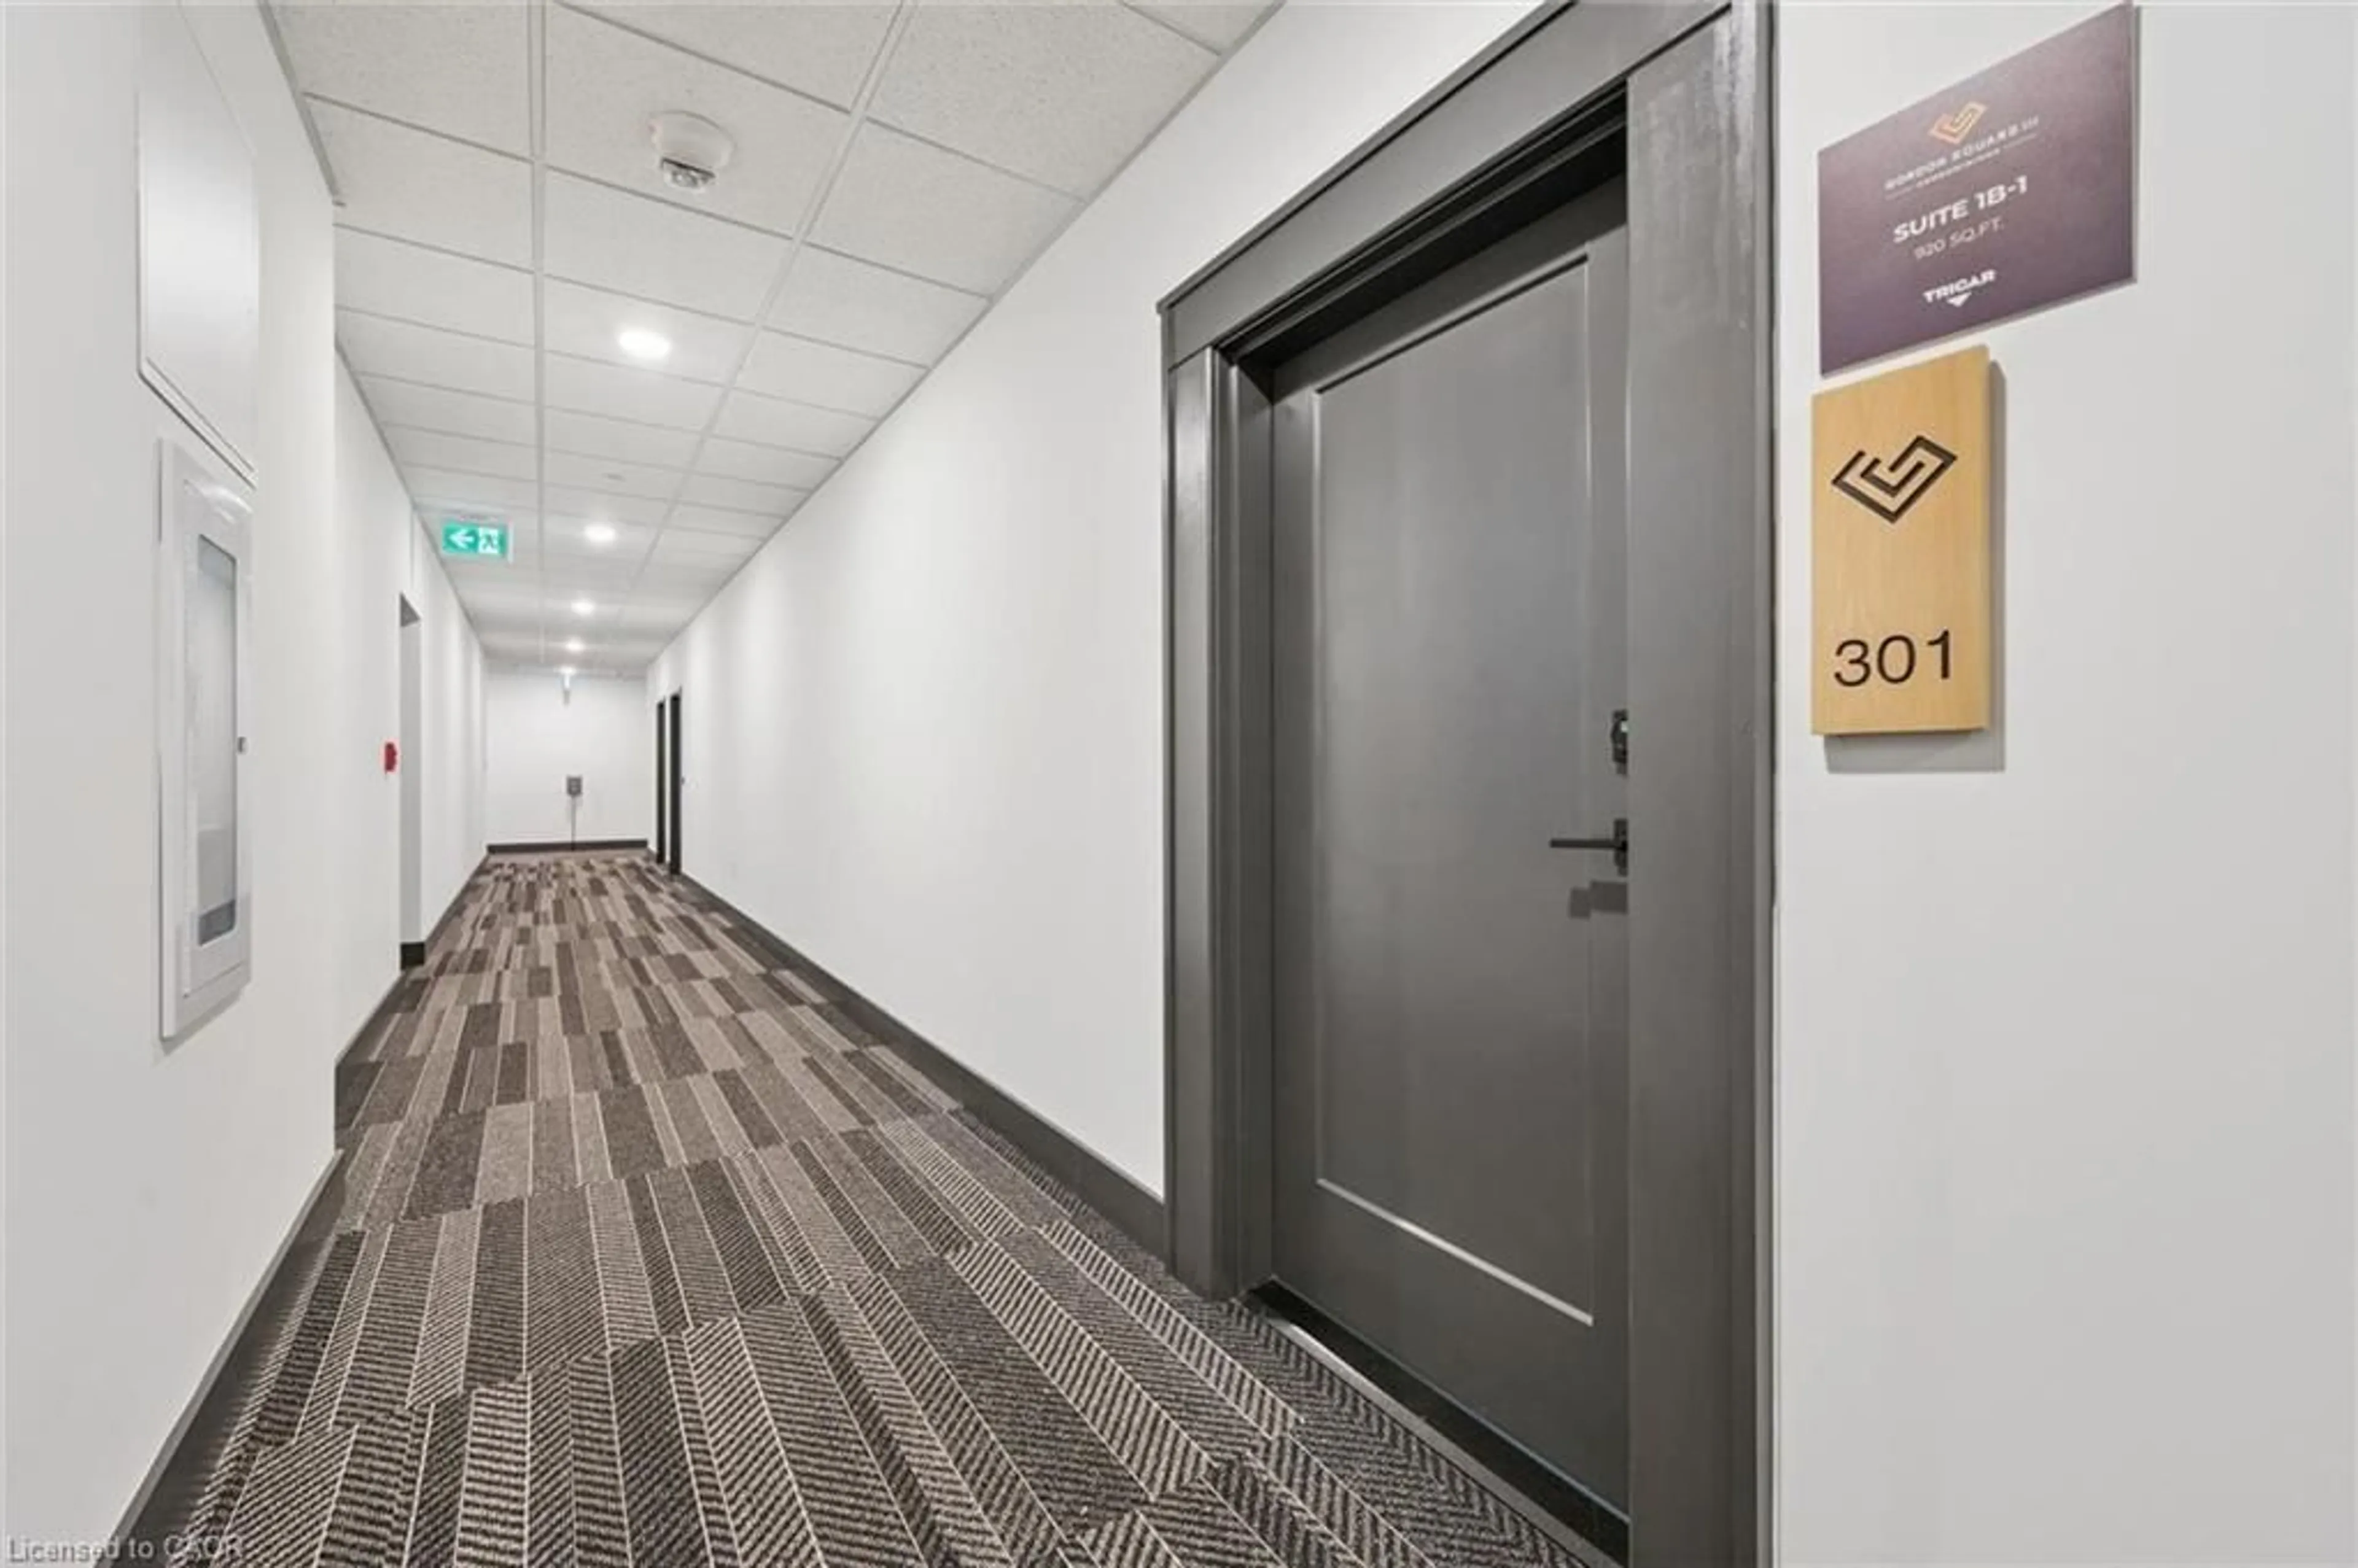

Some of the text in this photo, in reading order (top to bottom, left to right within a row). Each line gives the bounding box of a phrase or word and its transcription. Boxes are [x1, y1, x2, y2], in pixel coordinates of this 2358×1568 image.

[1893, 175, 2027, 244] SUITE 1B-1
[1914, 238, 1946, 261] 920
[1922, 268, 1996, 303] TRICAR
[1834, 629, 1951, 687] 301
